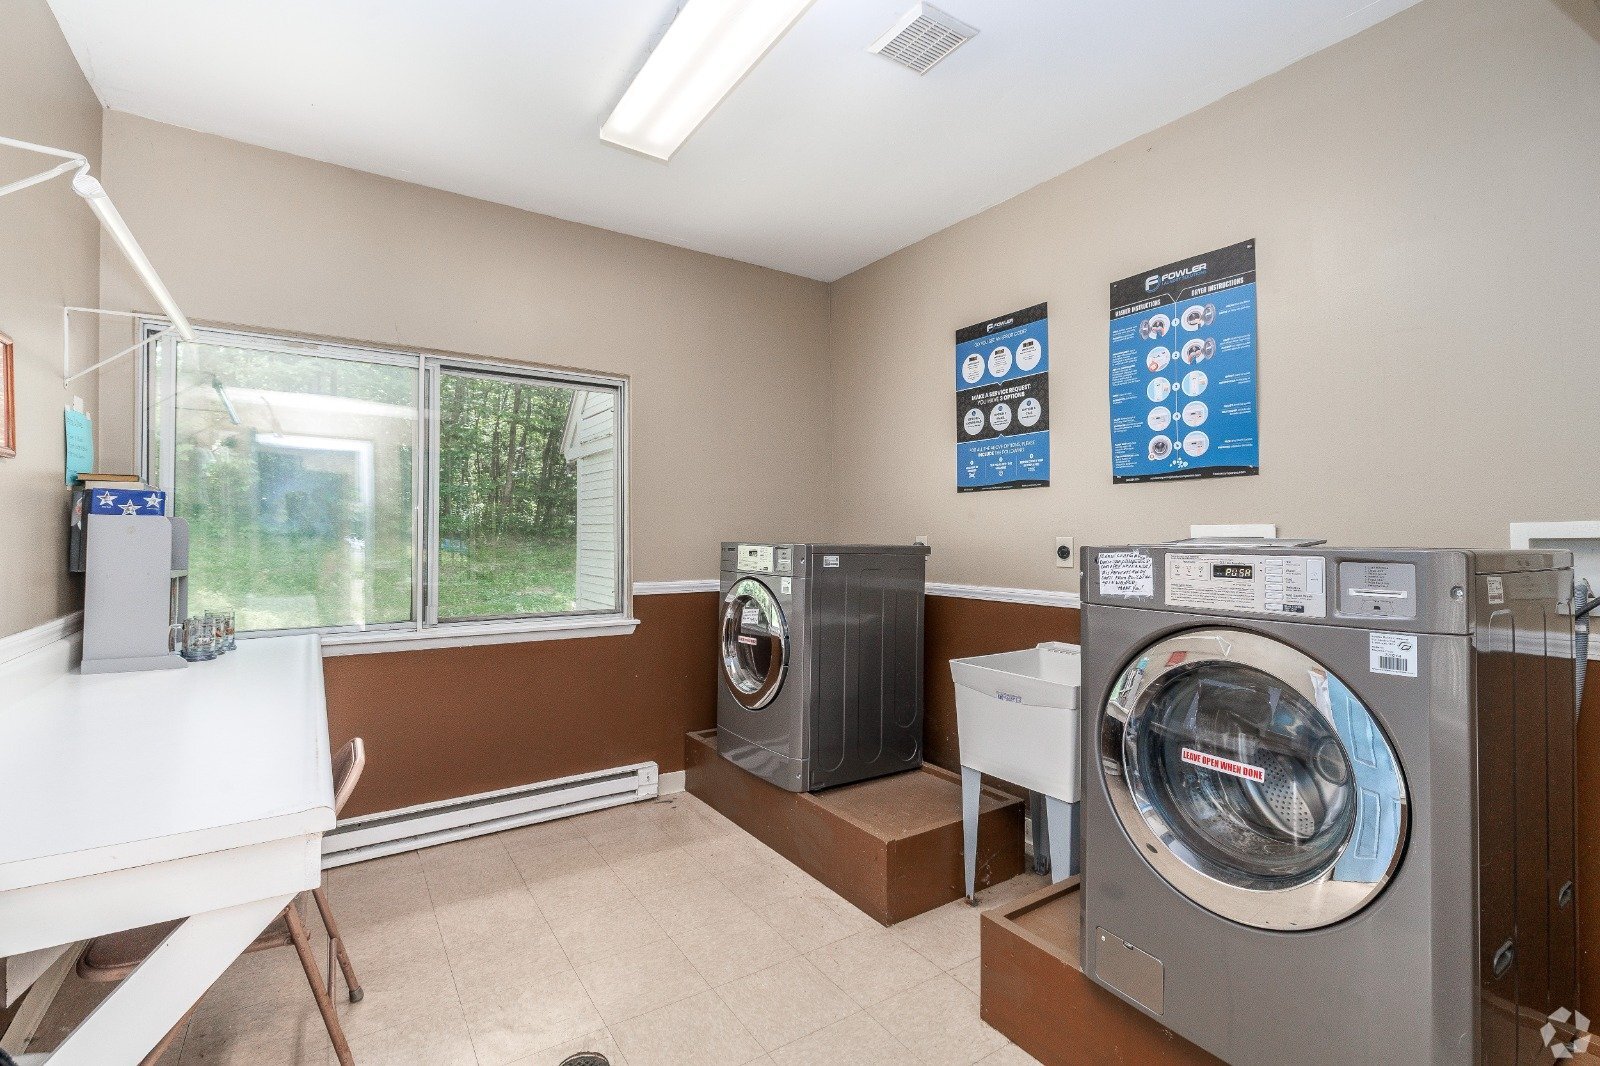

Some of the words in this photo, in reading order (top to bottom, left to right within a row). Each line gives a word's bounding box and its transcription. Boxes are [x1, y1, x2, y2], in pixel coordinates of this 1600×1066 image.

[1161, 262, 1207, 281] FOWLER
[1191, 285, 1207, 297] DRYER
[1207, 276, 1244, 293] INSTRUCTIONS
[1114, 307, 1131, 317] WASHER
[1131, 299, 1161, 313] INSTRUCTIONS
[993, 318, 1014, 328] FOWLER
[971, 393, 985, 401] MAKE
[989, 387, 1009, 397] SERVICE
[1003, 391, 1025, 400] OPTIONS
[1182, 750, 1201, 762] LEAVE
[1202, 756, 1220, 768] OPEN
[1220, 761, 1242, 774] WHEN
[1242, 767, 1263, 780] DONE
